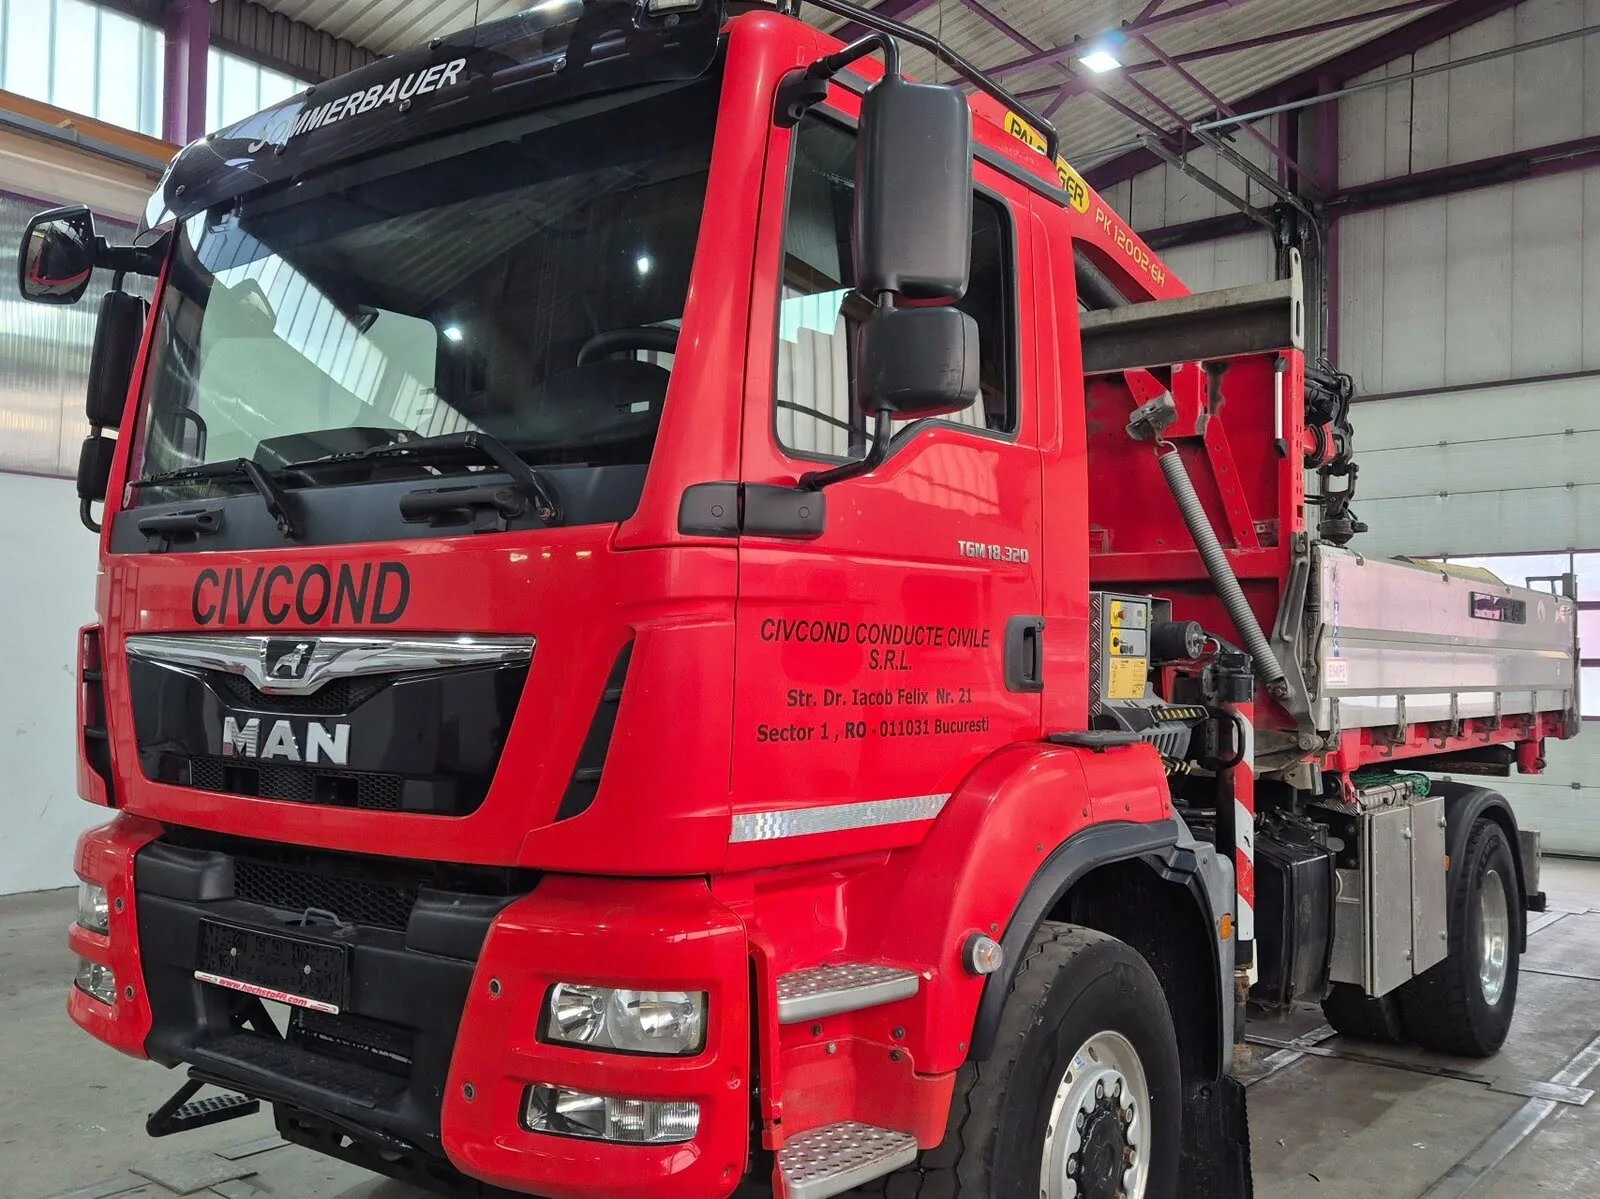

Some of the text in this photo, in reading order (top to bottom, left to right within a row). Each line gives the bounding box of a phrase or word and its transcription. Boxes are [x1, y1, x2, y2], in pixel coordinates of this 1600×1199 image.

[1095, 207, 1114, 236] PK
[957, 540, 1030, 563] TGM 18.320
[191, 561, 411, 626] CIVCOND
[760, 617, 991, 648] CIVCOND CONDUCTE CIVILE
[868, 648, 913, 671] S.R.L.
[786, 688, 973, 708] Str. Dr. Iacob Felix Nr. 21
[222, 716, 351, 766] MAN
[756, 723, 814, 743] Sector
[820, 723, 829, 741] 1
[844, 721, 867, 739] RO
[879, 719, 930, 738] 011031
[934, 717, 990, 735] Bucuresti
